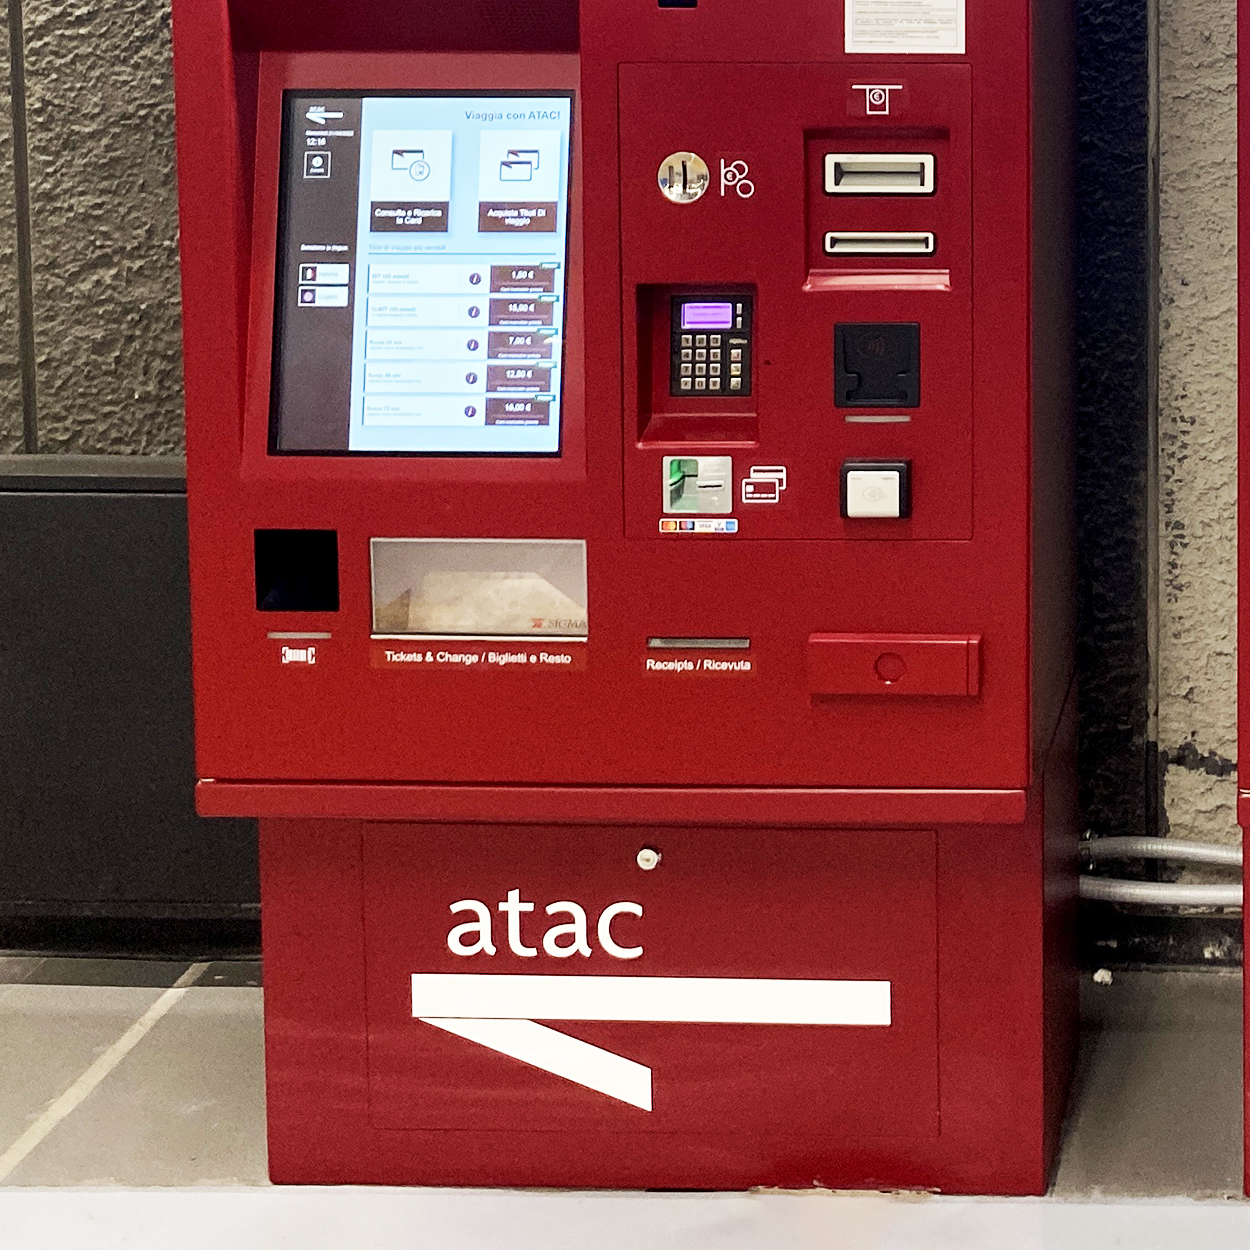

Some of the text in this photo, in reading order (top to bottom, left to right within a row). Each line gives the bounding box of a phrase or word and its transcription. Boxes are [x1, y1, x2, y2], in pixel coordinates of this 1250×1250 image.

[465, 111, 502, 121] Viaggia
[529, 111, 560, 119] ATAC!
[385, 651, 422, 662] Tickets
[426, 651, 433, 662] &
[437, 652, 478, 665] Change
[488, 652, 527, 665] Biglietti
[540, 653, 571, 663] Resto
[646, 659, 694, 672] Receipts
[704, 660, 751, 670] Ricevuta
[448, 889, 643, 959] atac
